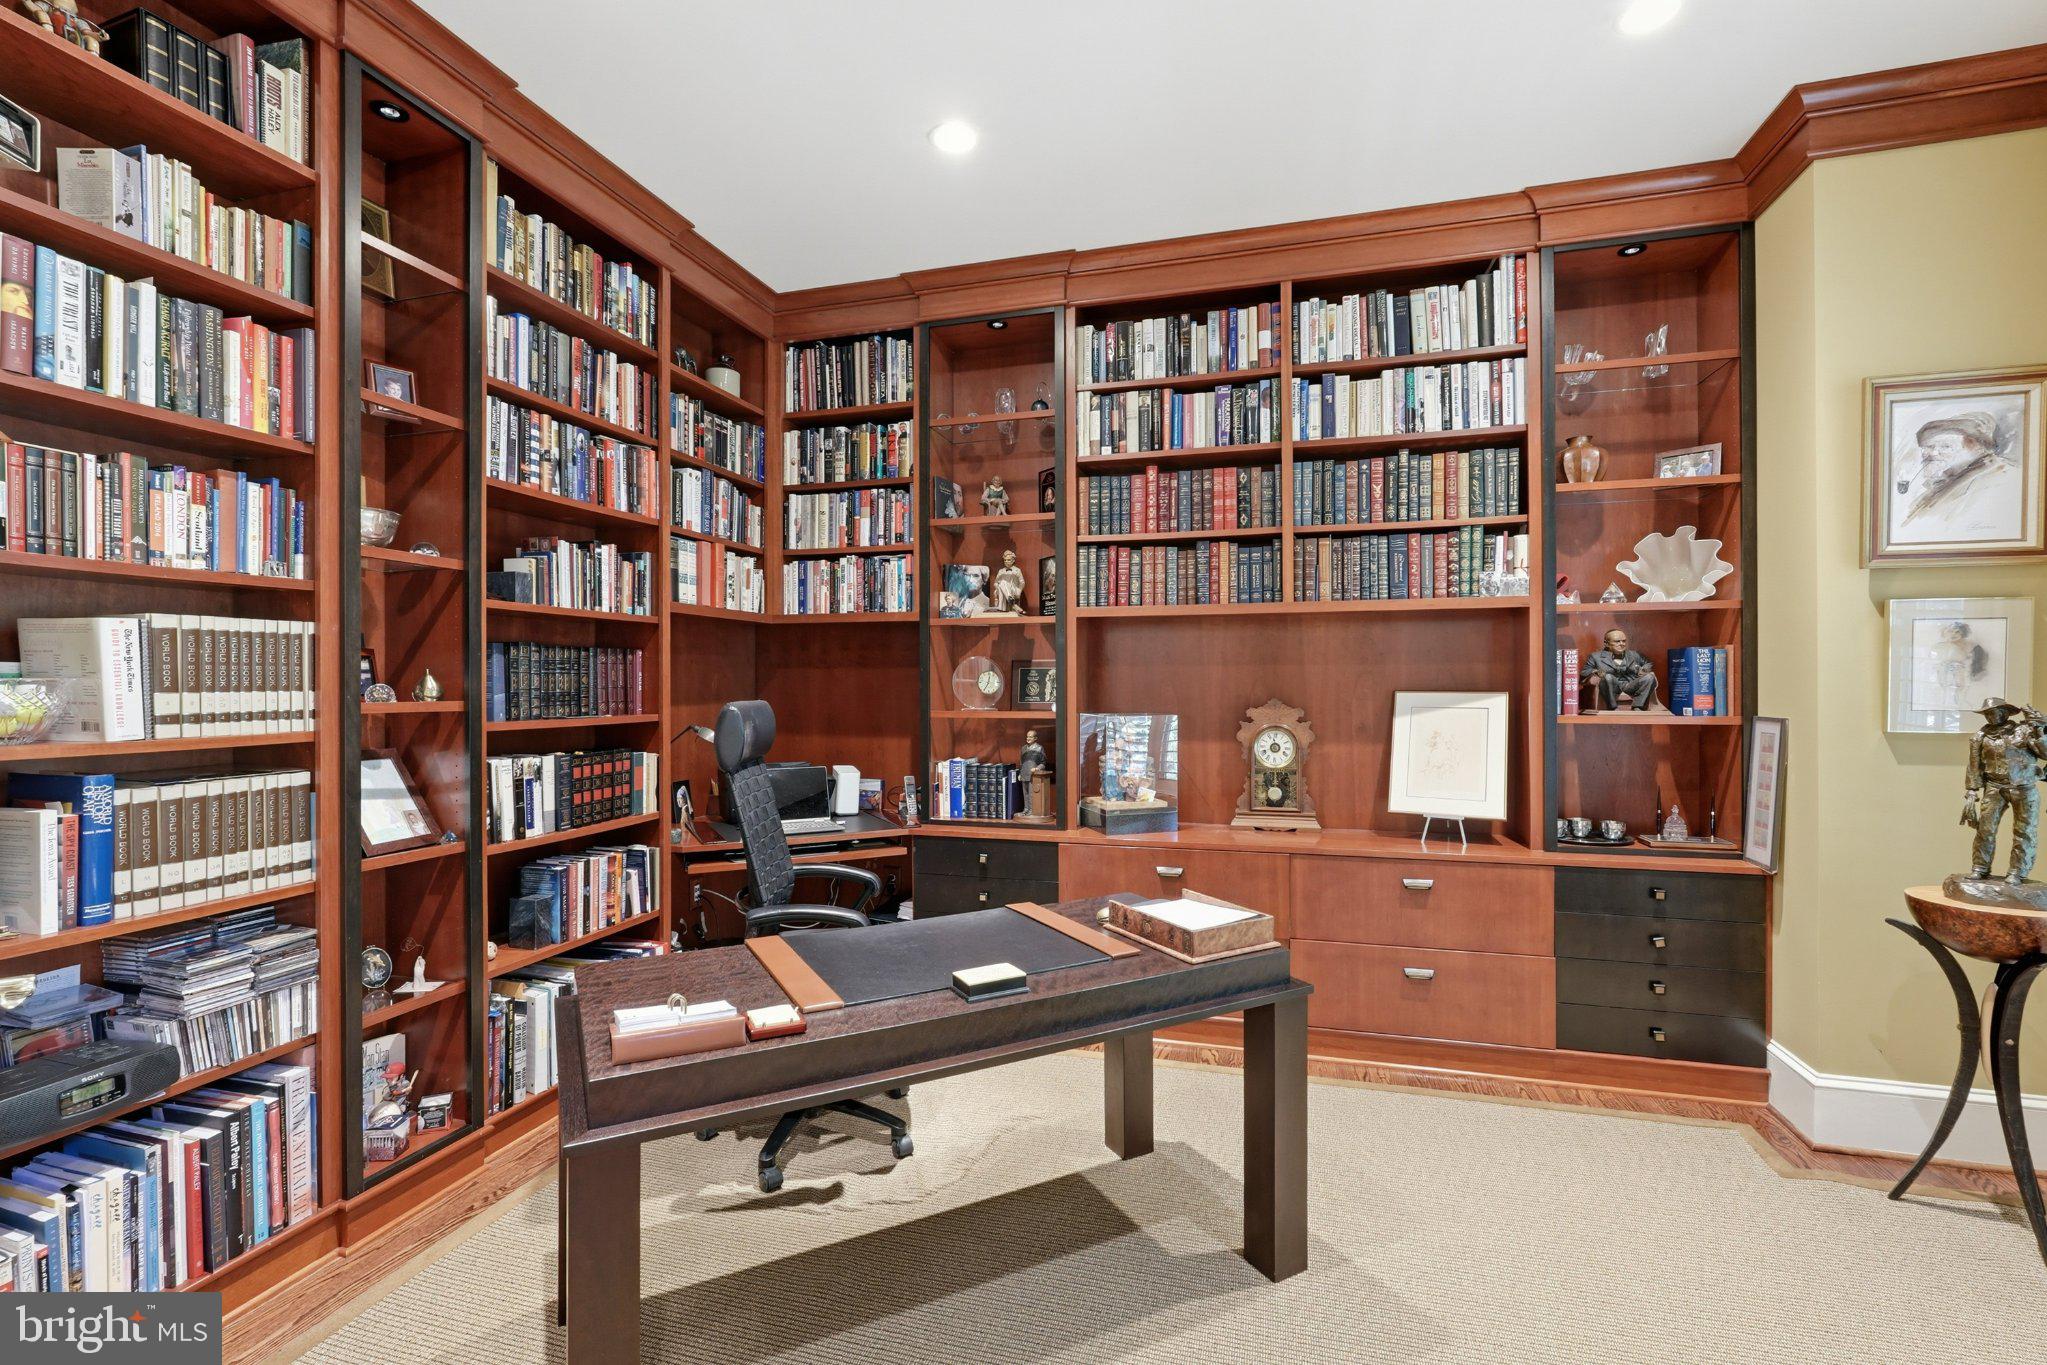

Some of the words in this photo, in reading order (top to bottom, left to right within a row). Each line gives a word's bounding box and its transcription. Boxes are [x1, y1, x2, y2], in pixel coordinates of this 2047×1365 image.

[266, 74, 281, 110] ROOTS
[63, 281, 79, 300] THE
[63, 302, 79, 333] TRUST
[160, 298, 170, 329] CHARLES
[183, 309, 191, 339] Fellowship
[161, 330, 170, 359] KURALT
[205, 309, 214, 367] WASHINGTON
[176, 493, 185, 540] LONDON
[195, 511, 203, 551] Scotland
[124, 629, 133, 641] The
[162, 634, 170, 662] WORLD
[113, 660, 122, 691] ESSENTIAL
[124, 656, 133, 673] York
[162, 665, 171, 687] BOOK
[127, 673, 135, 694] Times
[953, 762, 962, 789] TRUMAN
[82, 786, 94, 799] OF
[93, 785, 103, 824] HISTORY
[83, 798, 94, 818] ART
[103, 791, 112, 825] WORLD
[66, 819, 75, 833] THE
[142, 807, 150, 837] WORLD
[66, 834, 75, 848] SPY
[119, 841, 127, 866] BOOK
[143, 838, 151, 862] BOOK
[66, 849, 75, 871] COAST
[67, 875, 75, 888] TESS
[229, 1121, 239, 1146] Albert
[229, 1147, 240, 1171] Paley
[292, 1076, 307, 1219] FRANKENTHALER
[21, 1243, 33, 1281] PRINTS
